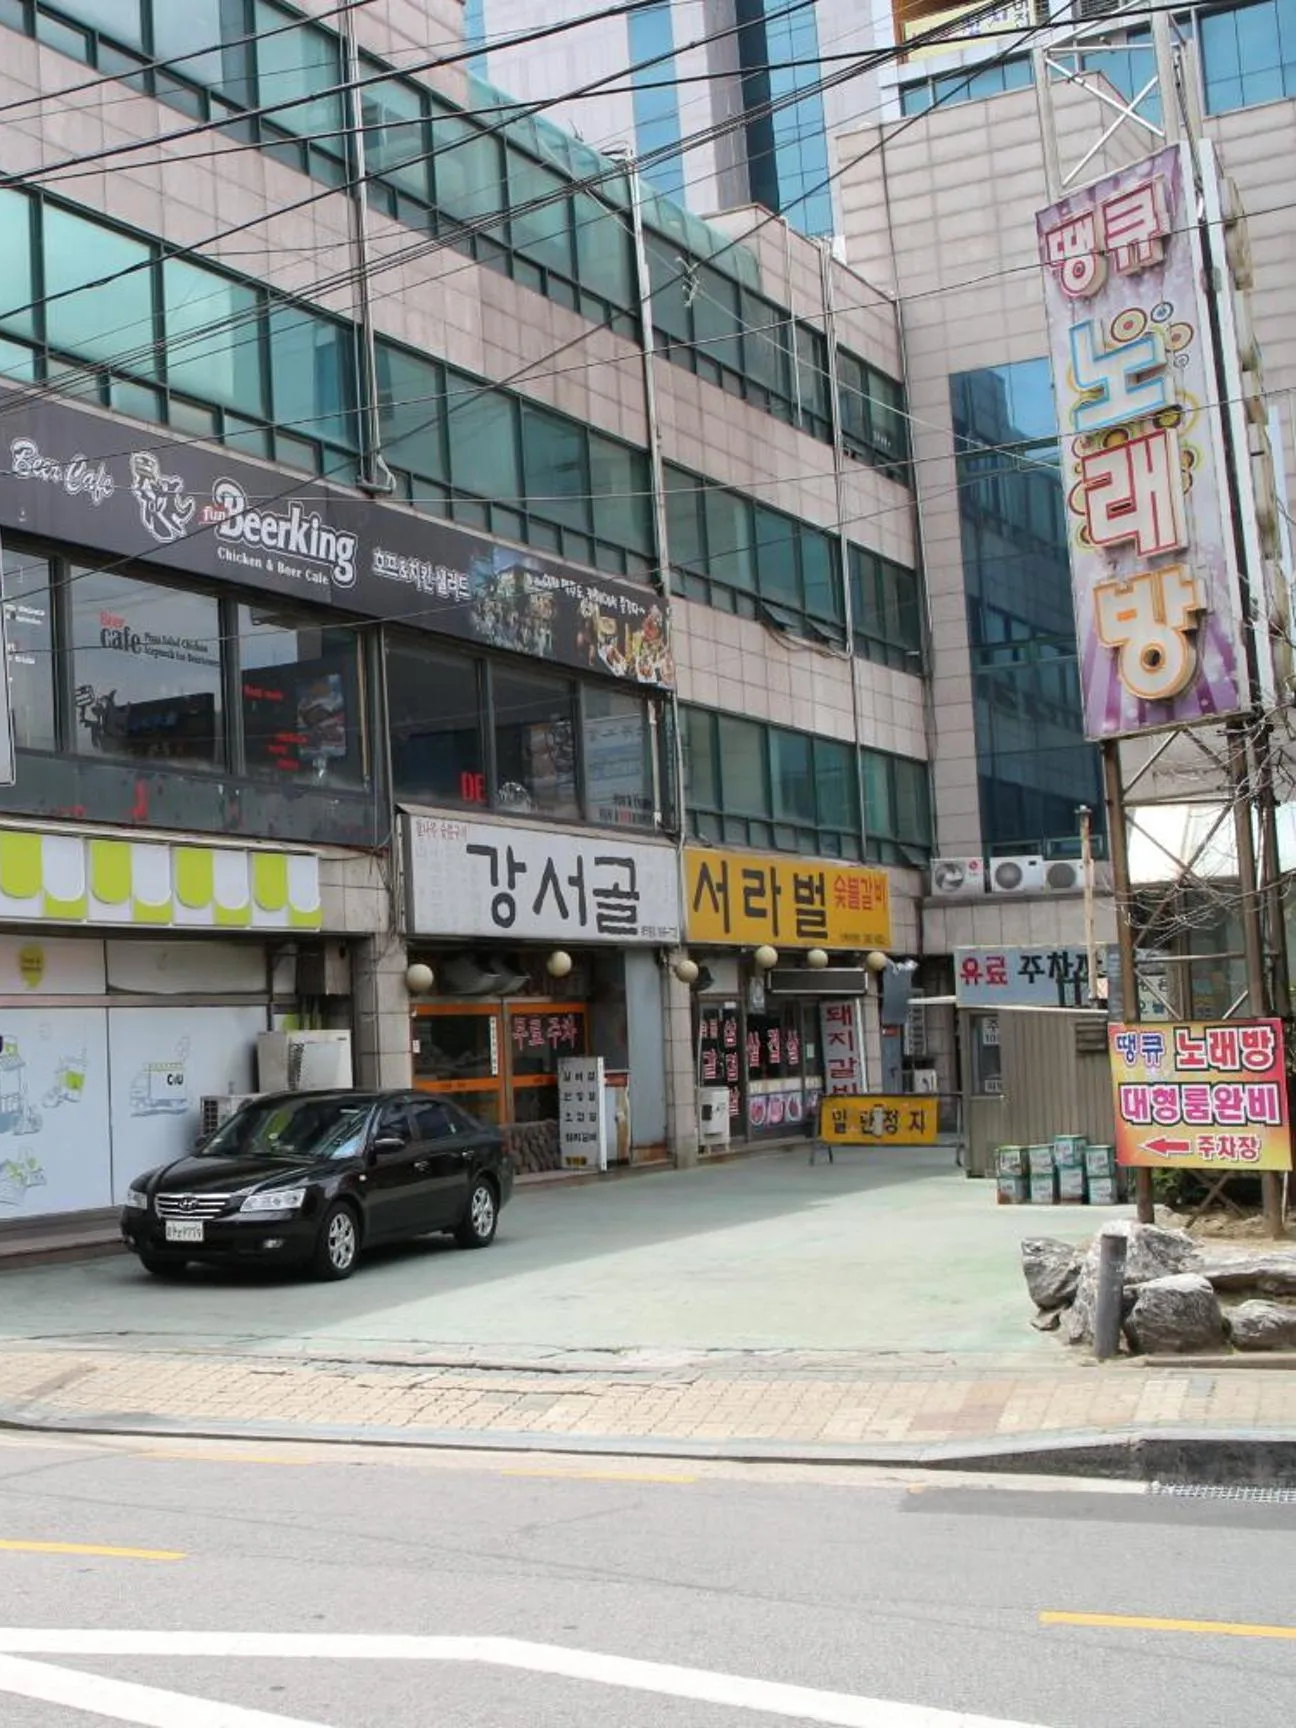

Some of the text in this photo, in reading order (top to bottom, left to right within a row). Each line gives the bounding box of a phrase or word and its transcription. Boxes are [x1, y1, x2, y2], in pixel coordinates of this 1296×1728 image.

[1046, 174, 1165, 298] 땡큐
[11, 439, 114, 504] Beer Cafe
[213, 479, 357, 587] Beerking
[1068, 319, 1208, 700] 노래방
[217, 546, 329, 585] Chicken & Beer Cafe
[465, 843, 640, 936] 강서골
[693, 859, 888, 940] 서라벌 숯불갈비
[960, 955, 1008, 986] 유료
[1115, 1027, 1278, 1071] 땡큐 노래방
[167, 1074, 184, 1086] CU
[1119, 1083, 1281, 1126] 대형룸완비
[1196, 1135, 1261, 1163] 주차장
